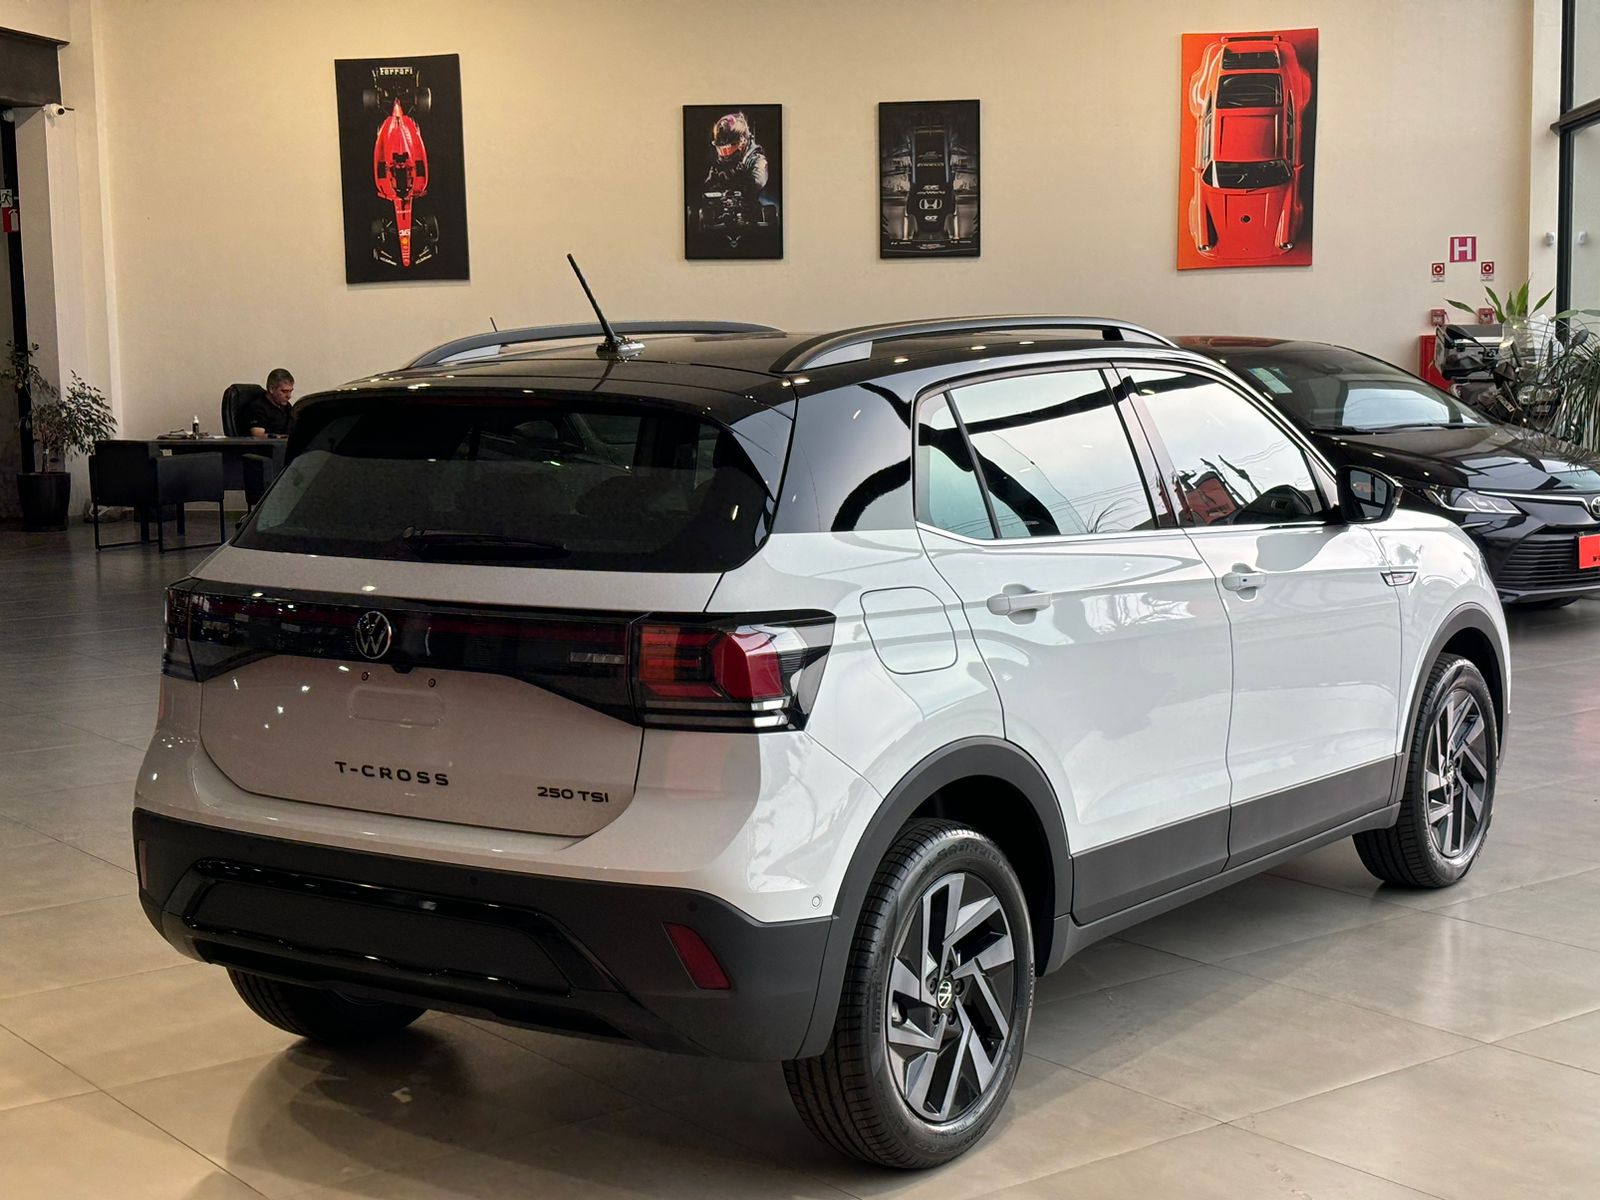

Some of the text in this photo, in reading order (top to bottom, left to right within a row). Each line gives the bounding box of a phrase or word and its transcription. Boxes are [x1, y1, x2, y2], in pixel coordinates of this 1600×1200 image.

[379, 66, 413, 76] Ferrari
[334, 761, 449, 786] T-CROSS
[537, 786, 609, 803] 250 TSI
